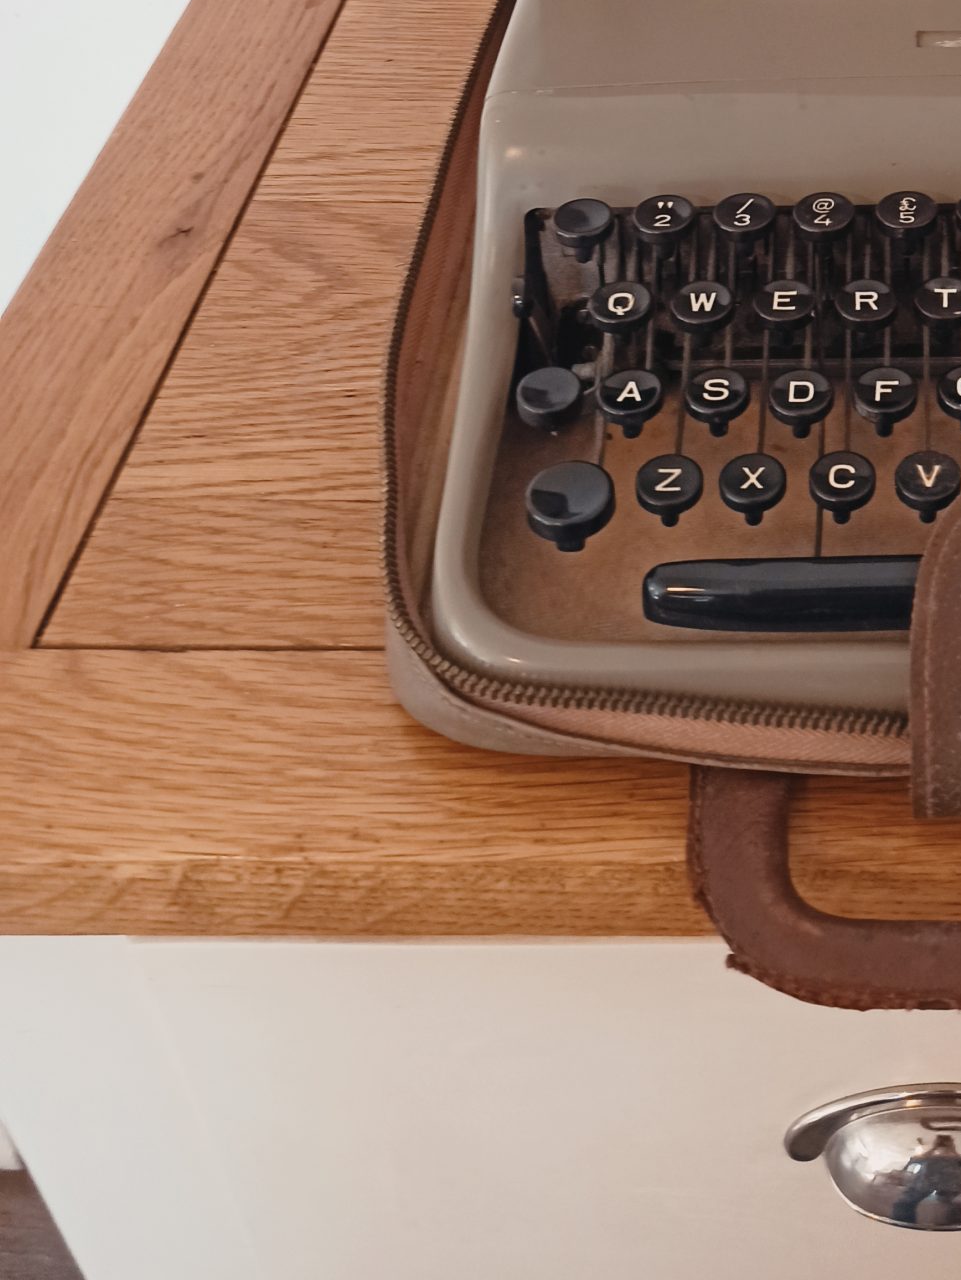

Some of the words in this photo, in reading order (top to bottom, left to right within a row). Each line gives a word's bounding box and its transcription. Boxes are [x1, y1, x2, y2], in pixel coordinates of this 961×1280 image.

[812, 198, 835, 214] @
[653, 214, 672, 227] 2
[733, 211, 751, 226] 3
[813, 214, 832, 226] 4
[899, 211, 915, 224] 5
[607, 292, 635, 316] Q
[689, 292, 717, 312] W
[772, 290, 798, 310] E
[855, 291, 879, 311] R
[933, 288, 958, 308] T
[616, 381, 642, 402] A
[702, 378, 730, 401] S
[788, 380, 815, 403] D
[874, 380, 900, 402] F
[655, 468, 682, 492] Z
[740, 466, 765, 489] X
[829, 464, 856, 489] C
[916, 464, 941, 488] V
